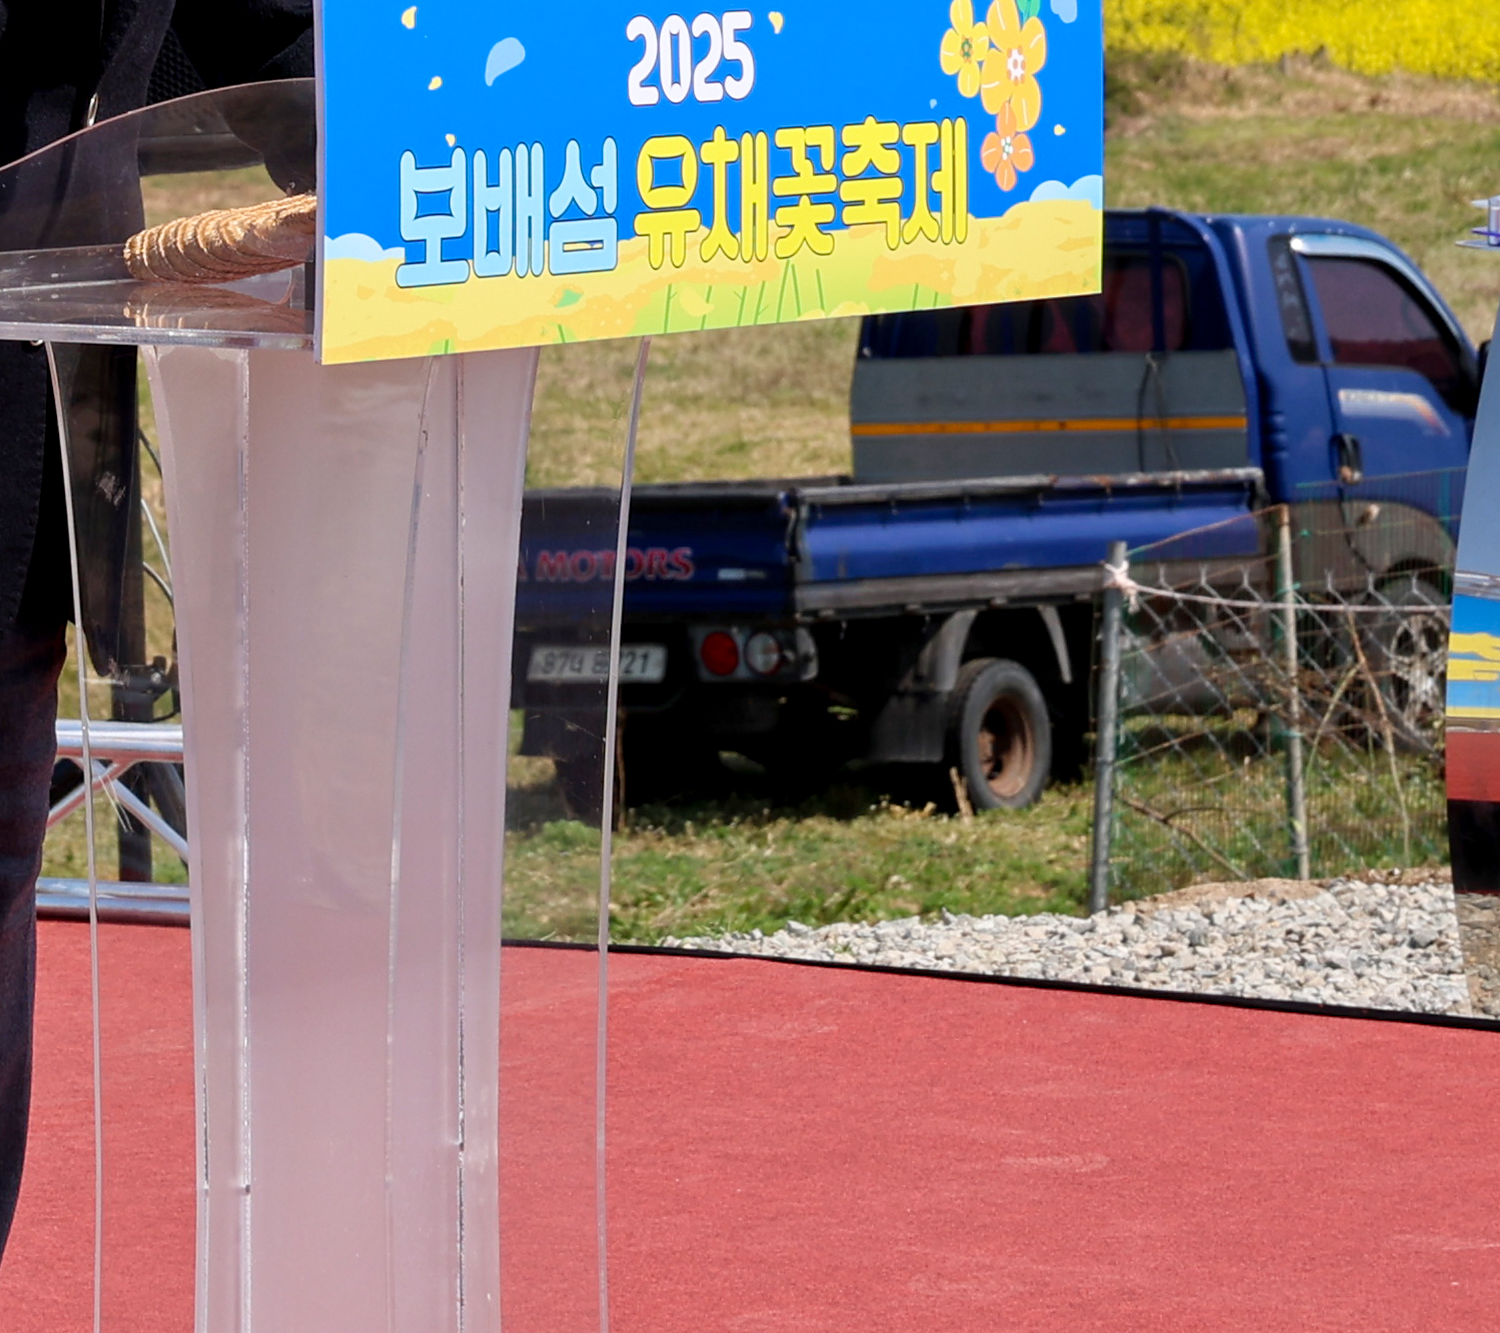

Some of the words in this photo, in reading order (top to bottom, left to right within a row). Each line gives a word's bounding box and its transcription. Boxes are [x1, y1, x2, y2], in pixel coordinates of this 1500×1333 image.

[626, 10, 756, 107] 2025
[394, 135, 619, 289] 보배섬
[634, 115, 969, 270] 유채꽃축제
